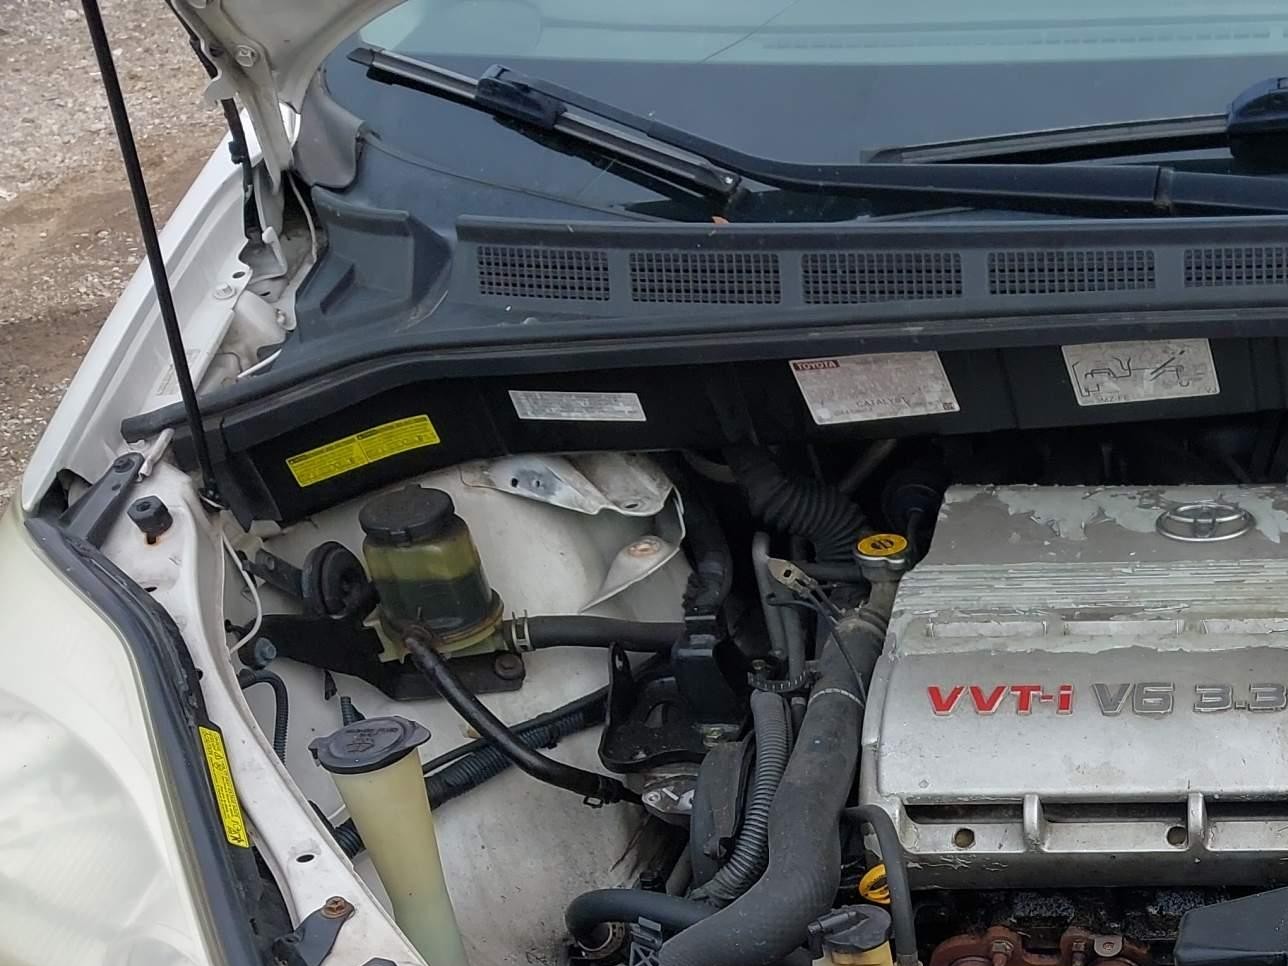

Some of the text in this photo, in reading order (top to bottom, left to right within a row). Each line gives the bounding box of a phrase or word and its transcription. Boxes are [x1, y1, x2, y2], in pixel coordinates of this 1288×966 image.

[797, 360, 837, 370] TOYOTA
[927, 682, 1288, 716] VVT-i V6 3.3
